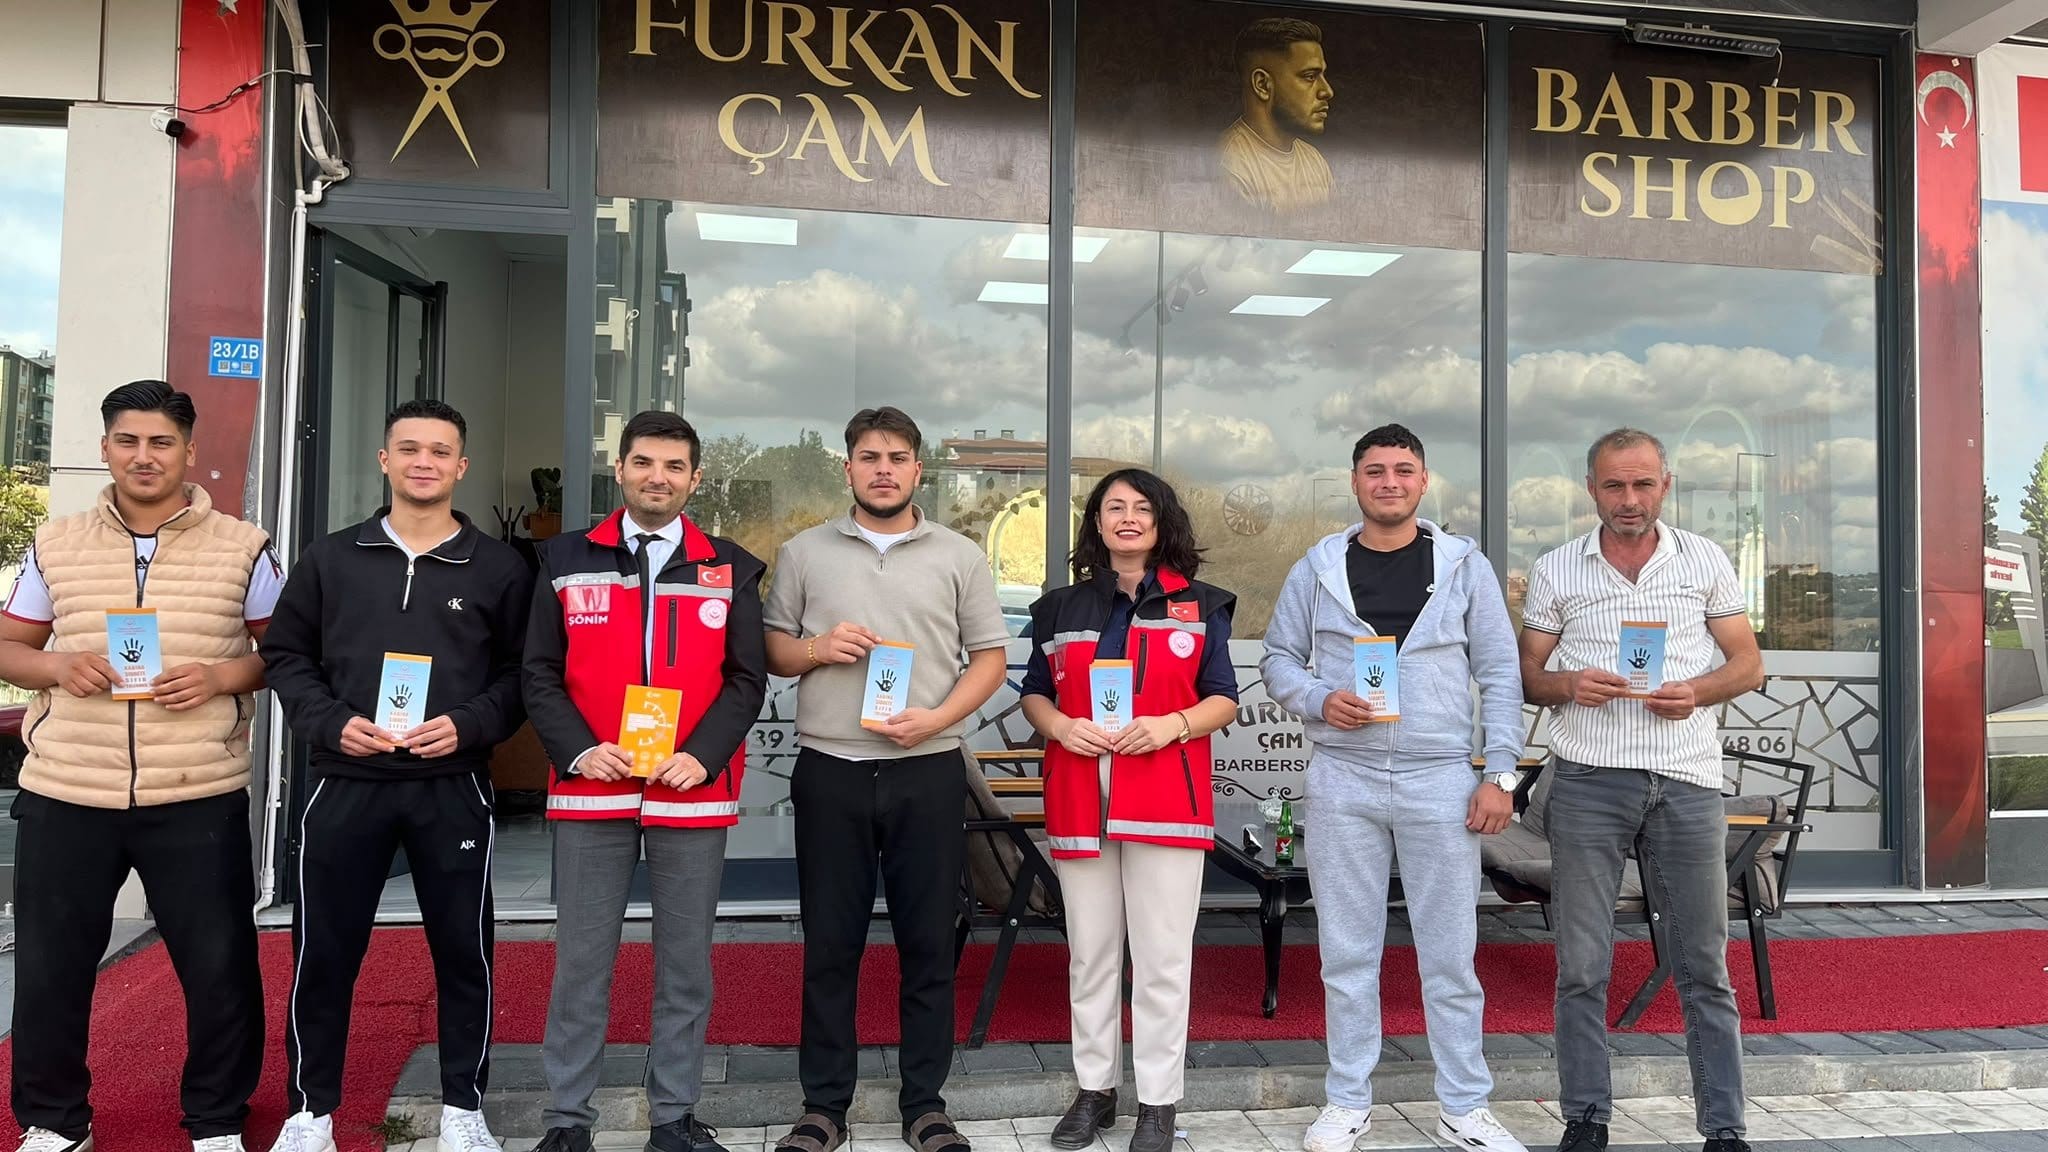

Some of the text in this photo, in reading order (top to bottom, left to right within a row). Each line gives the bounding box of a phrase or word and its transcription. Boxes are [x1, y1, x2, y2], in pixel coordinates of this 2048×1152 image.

[629, 0, 1042, 98] FURKAN
[718, 93, 951, 186] ÇAM
[1531, 66, 1868, 156] BARBER
[1580, 151, 1815, 229] SHOP
[213, 342, 259, 359] 23/1B
[1258, 732, 1302, 753] ÇAM
[1757, 736, 1786, 753] 06
